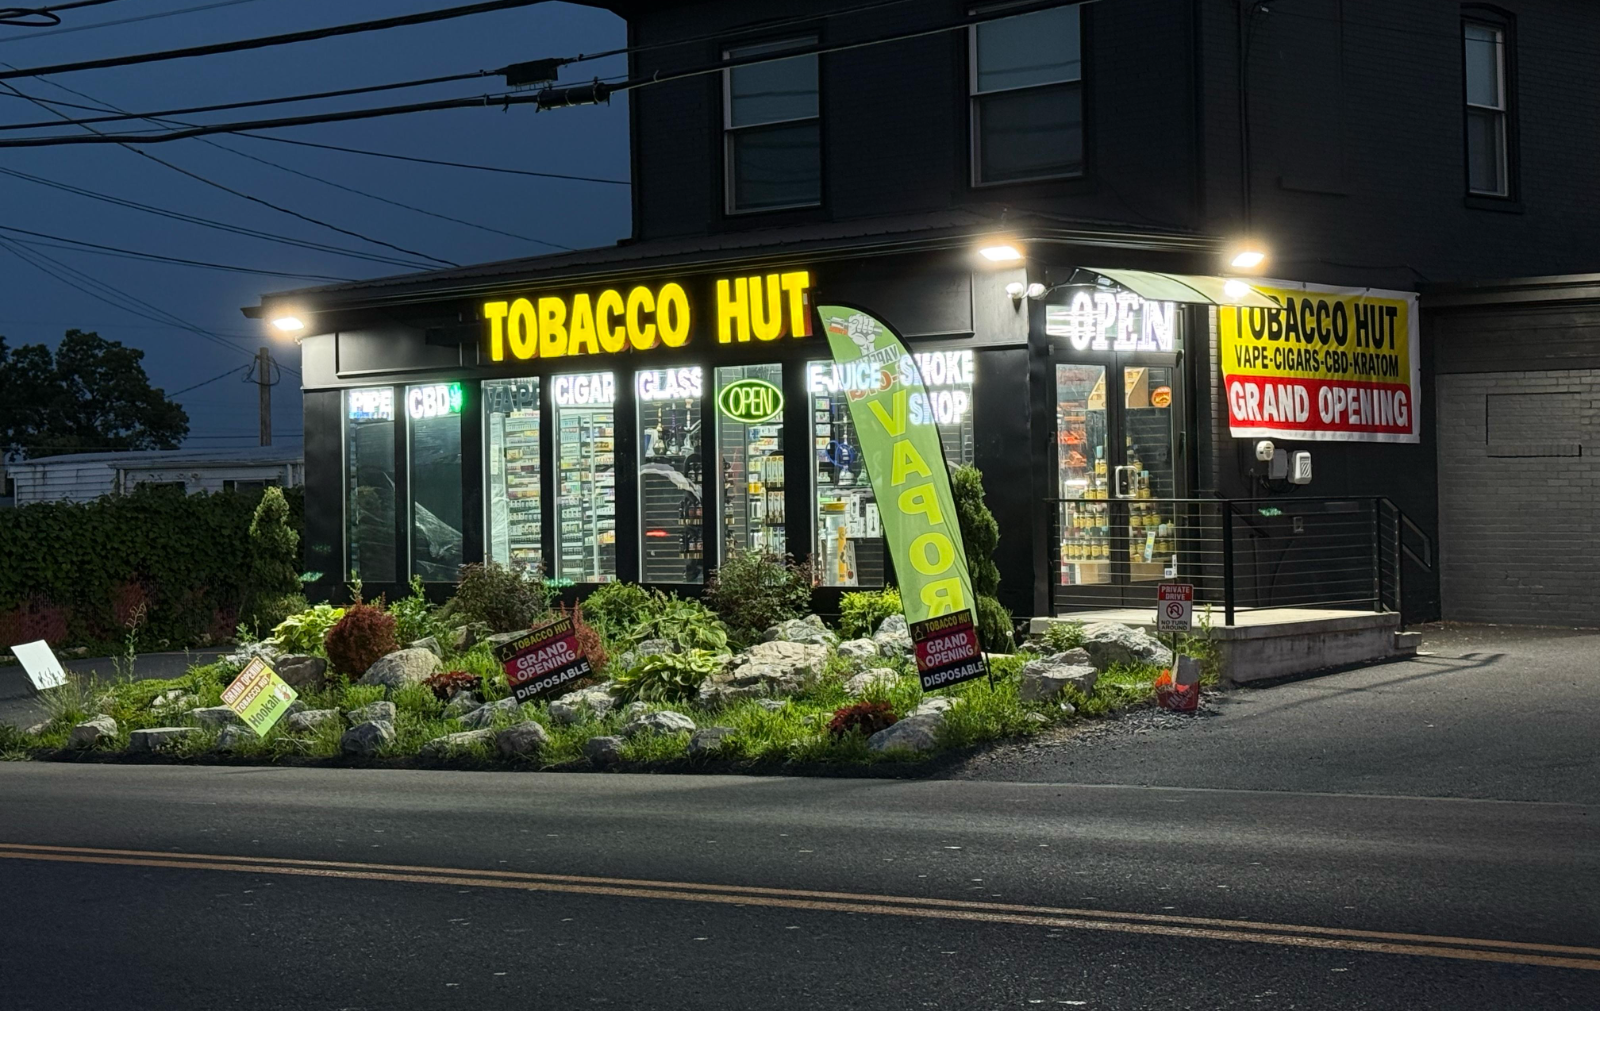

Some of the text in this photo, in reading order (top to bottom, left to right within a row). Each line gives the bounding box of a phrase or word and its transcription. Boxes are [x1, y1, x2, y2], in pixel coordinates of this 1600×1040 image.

[484, 270, 810, 361] TOBACCO HUT
[1070, 291, 1175, 351] OPEN
[1353, 303, 1398, 350] HUT
[809, 362, 882, 392] E-JUICE
[899, 350, 975, 387] SMOKE
[1234, 344, 1399, 377] VAPE-CIGARS-CBD-KRATOM
[555, 372, 616, 405] CIGAR
[637, 367, 703, 400] GLASS
[350, 390, 393, 414] PIPE
[408, 384, 450, 419] CBD
[729, 386, 773, 416] OPEN
[908, 389, 969, 426] SHOP
[1230, 380, 1409, 427] GRAND OPENING
[1161, 585, 1190, 594] PRIVATE
[513, 621, 571, 651] TOBACCO HUT
[925, 612, 970, 632] TOBACCO HUT
[517, 642, 567, 668] GRAND
[926, 645, 973, 666] OPENING
[927, 633, 967, 653] GRAND
[224, 660, 264, 703] GRAND OPENING
[517, 651, 575, 680] OPENING
[517, 662, 589, 699] DISPOSABLE
[924, 662, 984, 687] DISPOSABLE
[236, 675, 270, 711] TOBACCO HUT
[248, 695, 280, 727] Hookah
